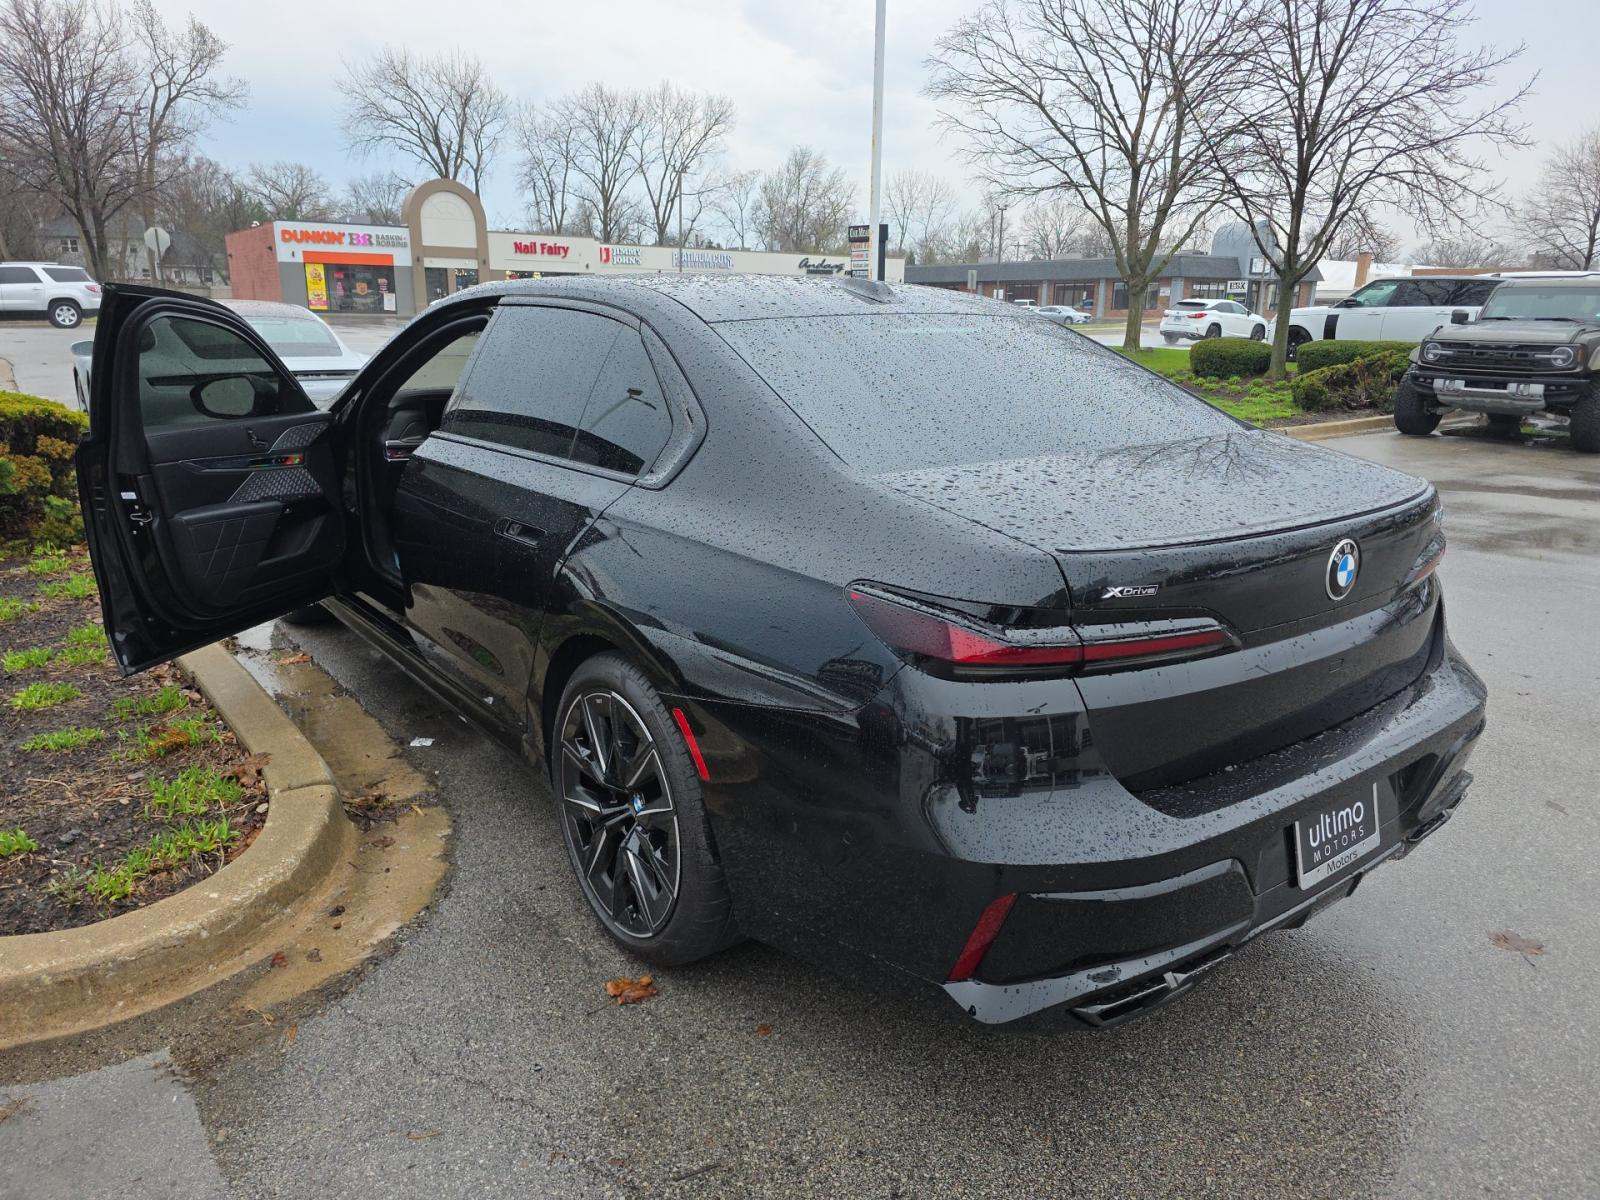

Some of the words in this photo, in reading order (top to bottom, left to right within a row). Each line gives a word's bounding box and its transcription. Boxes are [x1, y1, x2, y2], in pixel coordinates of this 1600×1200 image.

[514, 241, 537, 255] Nail
[540, 242, 569, 259] Fairy
[1309, 801, 1364, 848] ultimo
[1313, 825, 1365, 863] MOTORS
[1326, 850, 1359, 875] Motors
